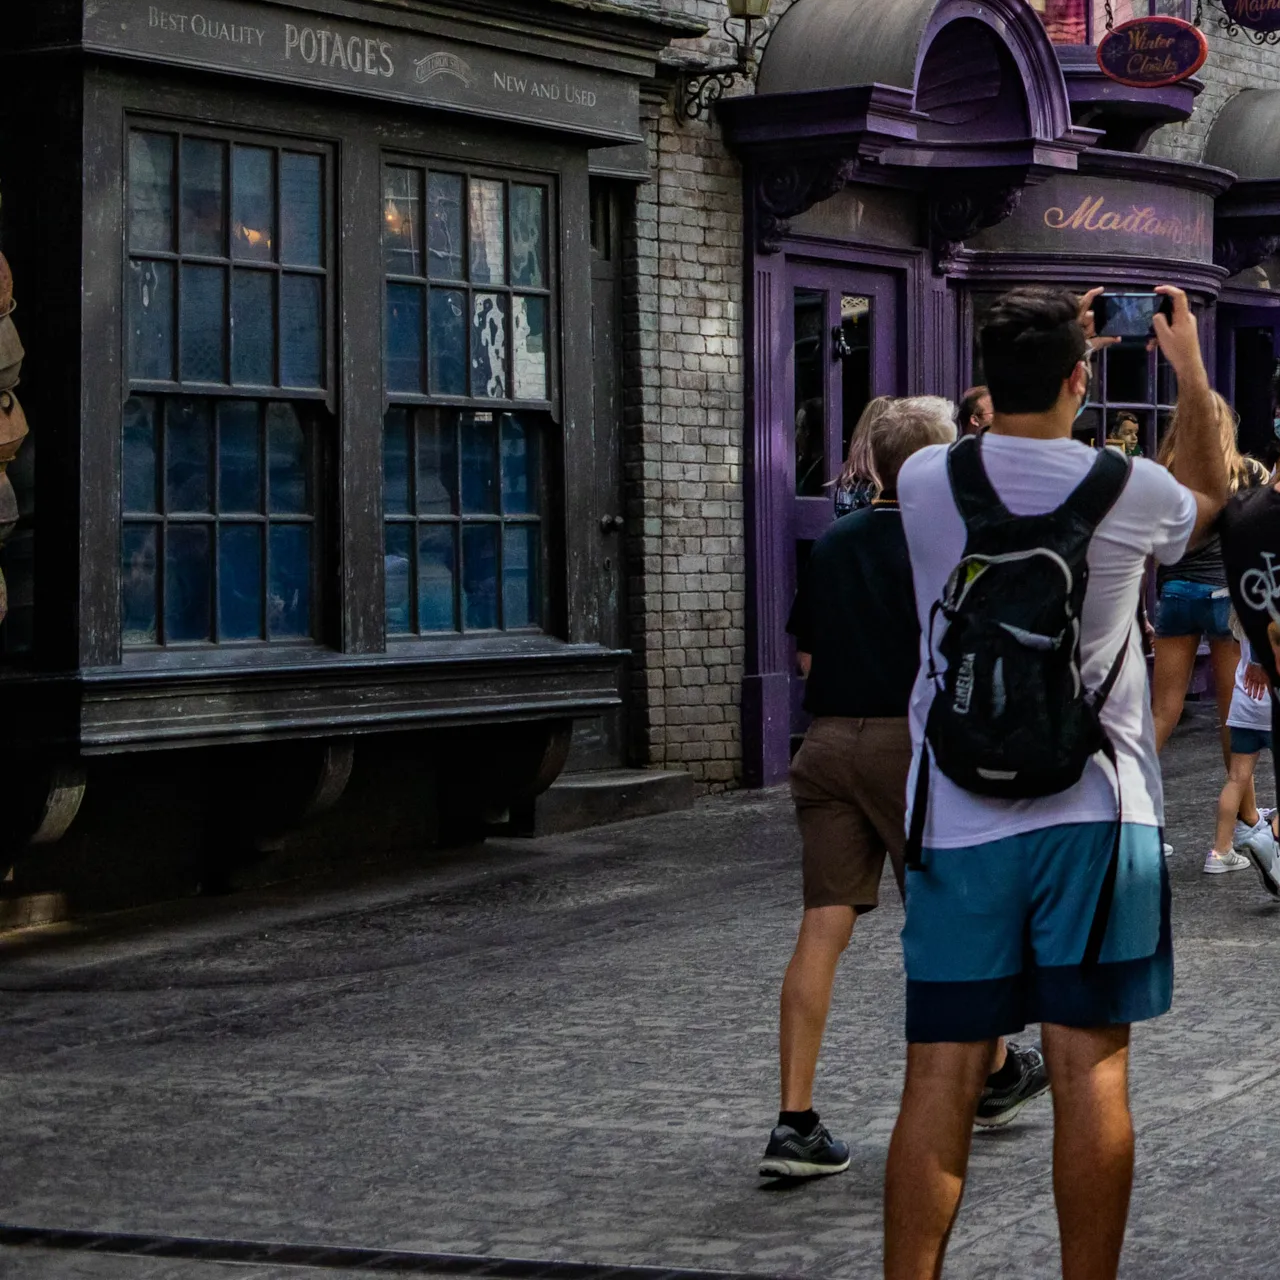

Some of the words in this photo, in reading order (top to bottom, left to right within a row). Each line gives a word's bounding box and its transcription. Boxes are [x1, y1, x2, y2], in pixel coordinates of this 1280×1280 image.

[190, 14, 265, 47] QUALITY
[284, 22, 396, 78] POTAGE'S
[493, 70, 528, 93] NEW
[530, 82, 560, 101] AND
[564, 83, 597, 108] USED
